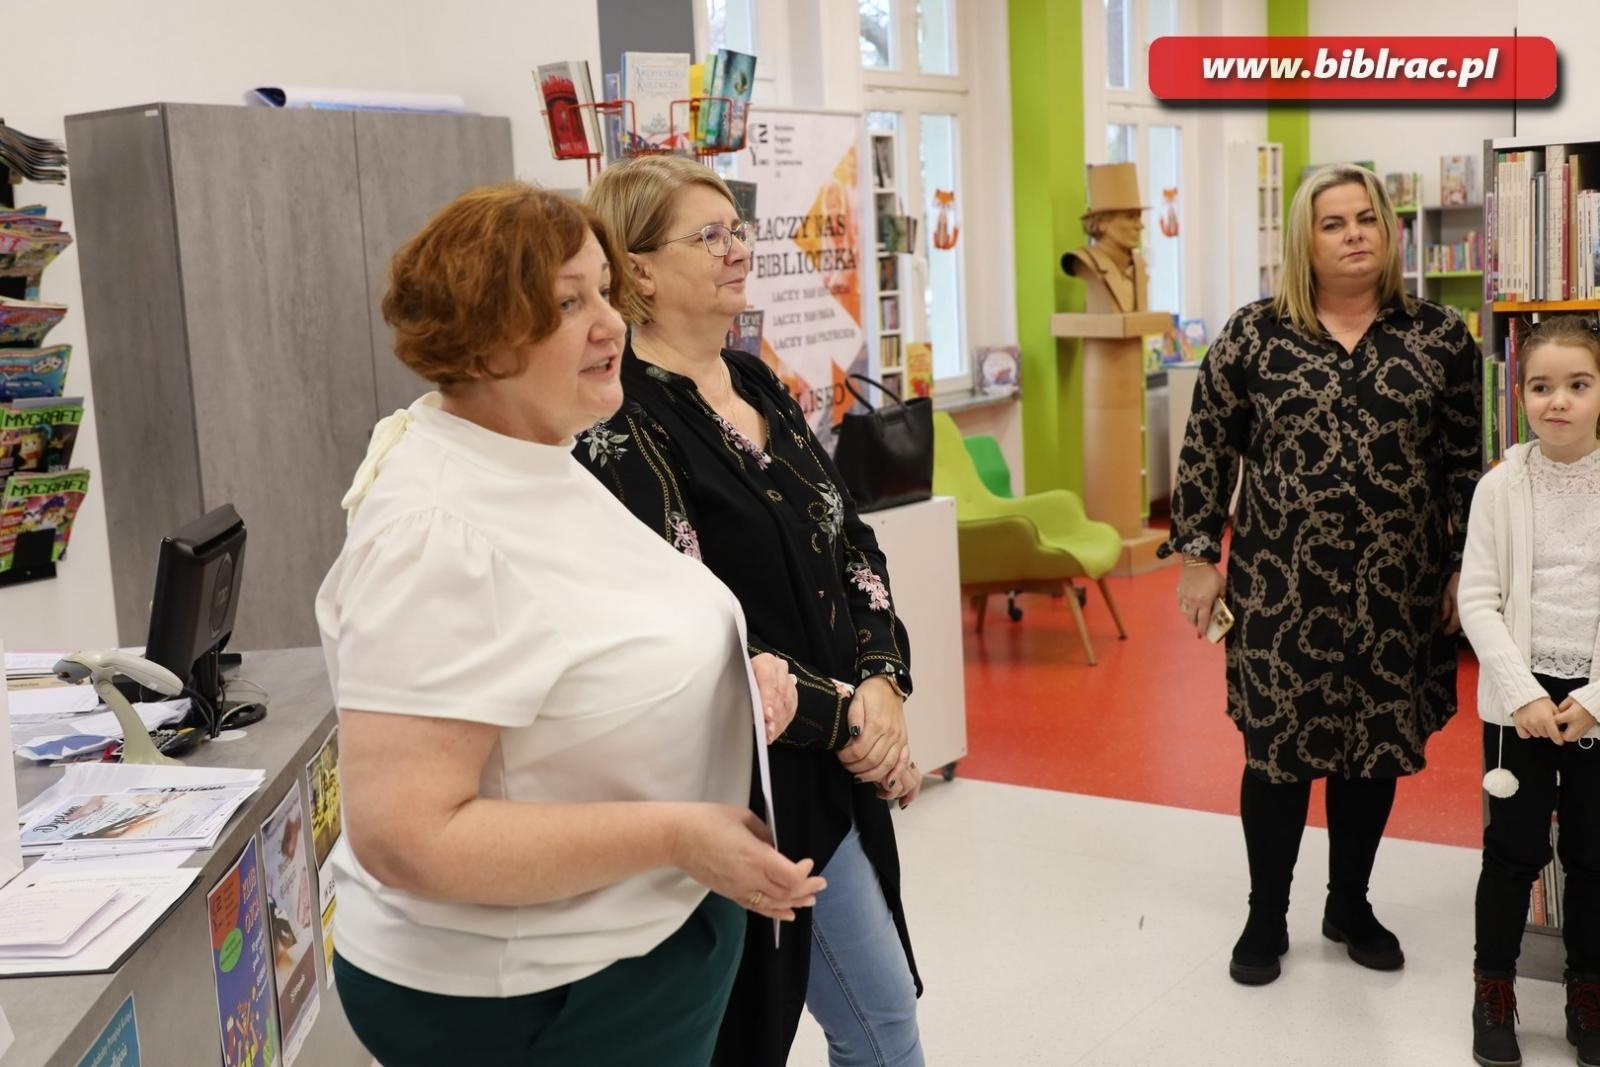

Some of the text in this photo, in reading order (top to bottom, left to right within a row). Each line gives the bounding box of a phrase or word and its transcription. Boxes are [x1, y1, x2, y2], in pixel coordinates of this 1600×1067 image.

[757, 248, 857, 279] BIBLIOTEKA
[5, 410, 81, 427] MYCRAFT
[11, 479, 87, 496] MYCRAFT
